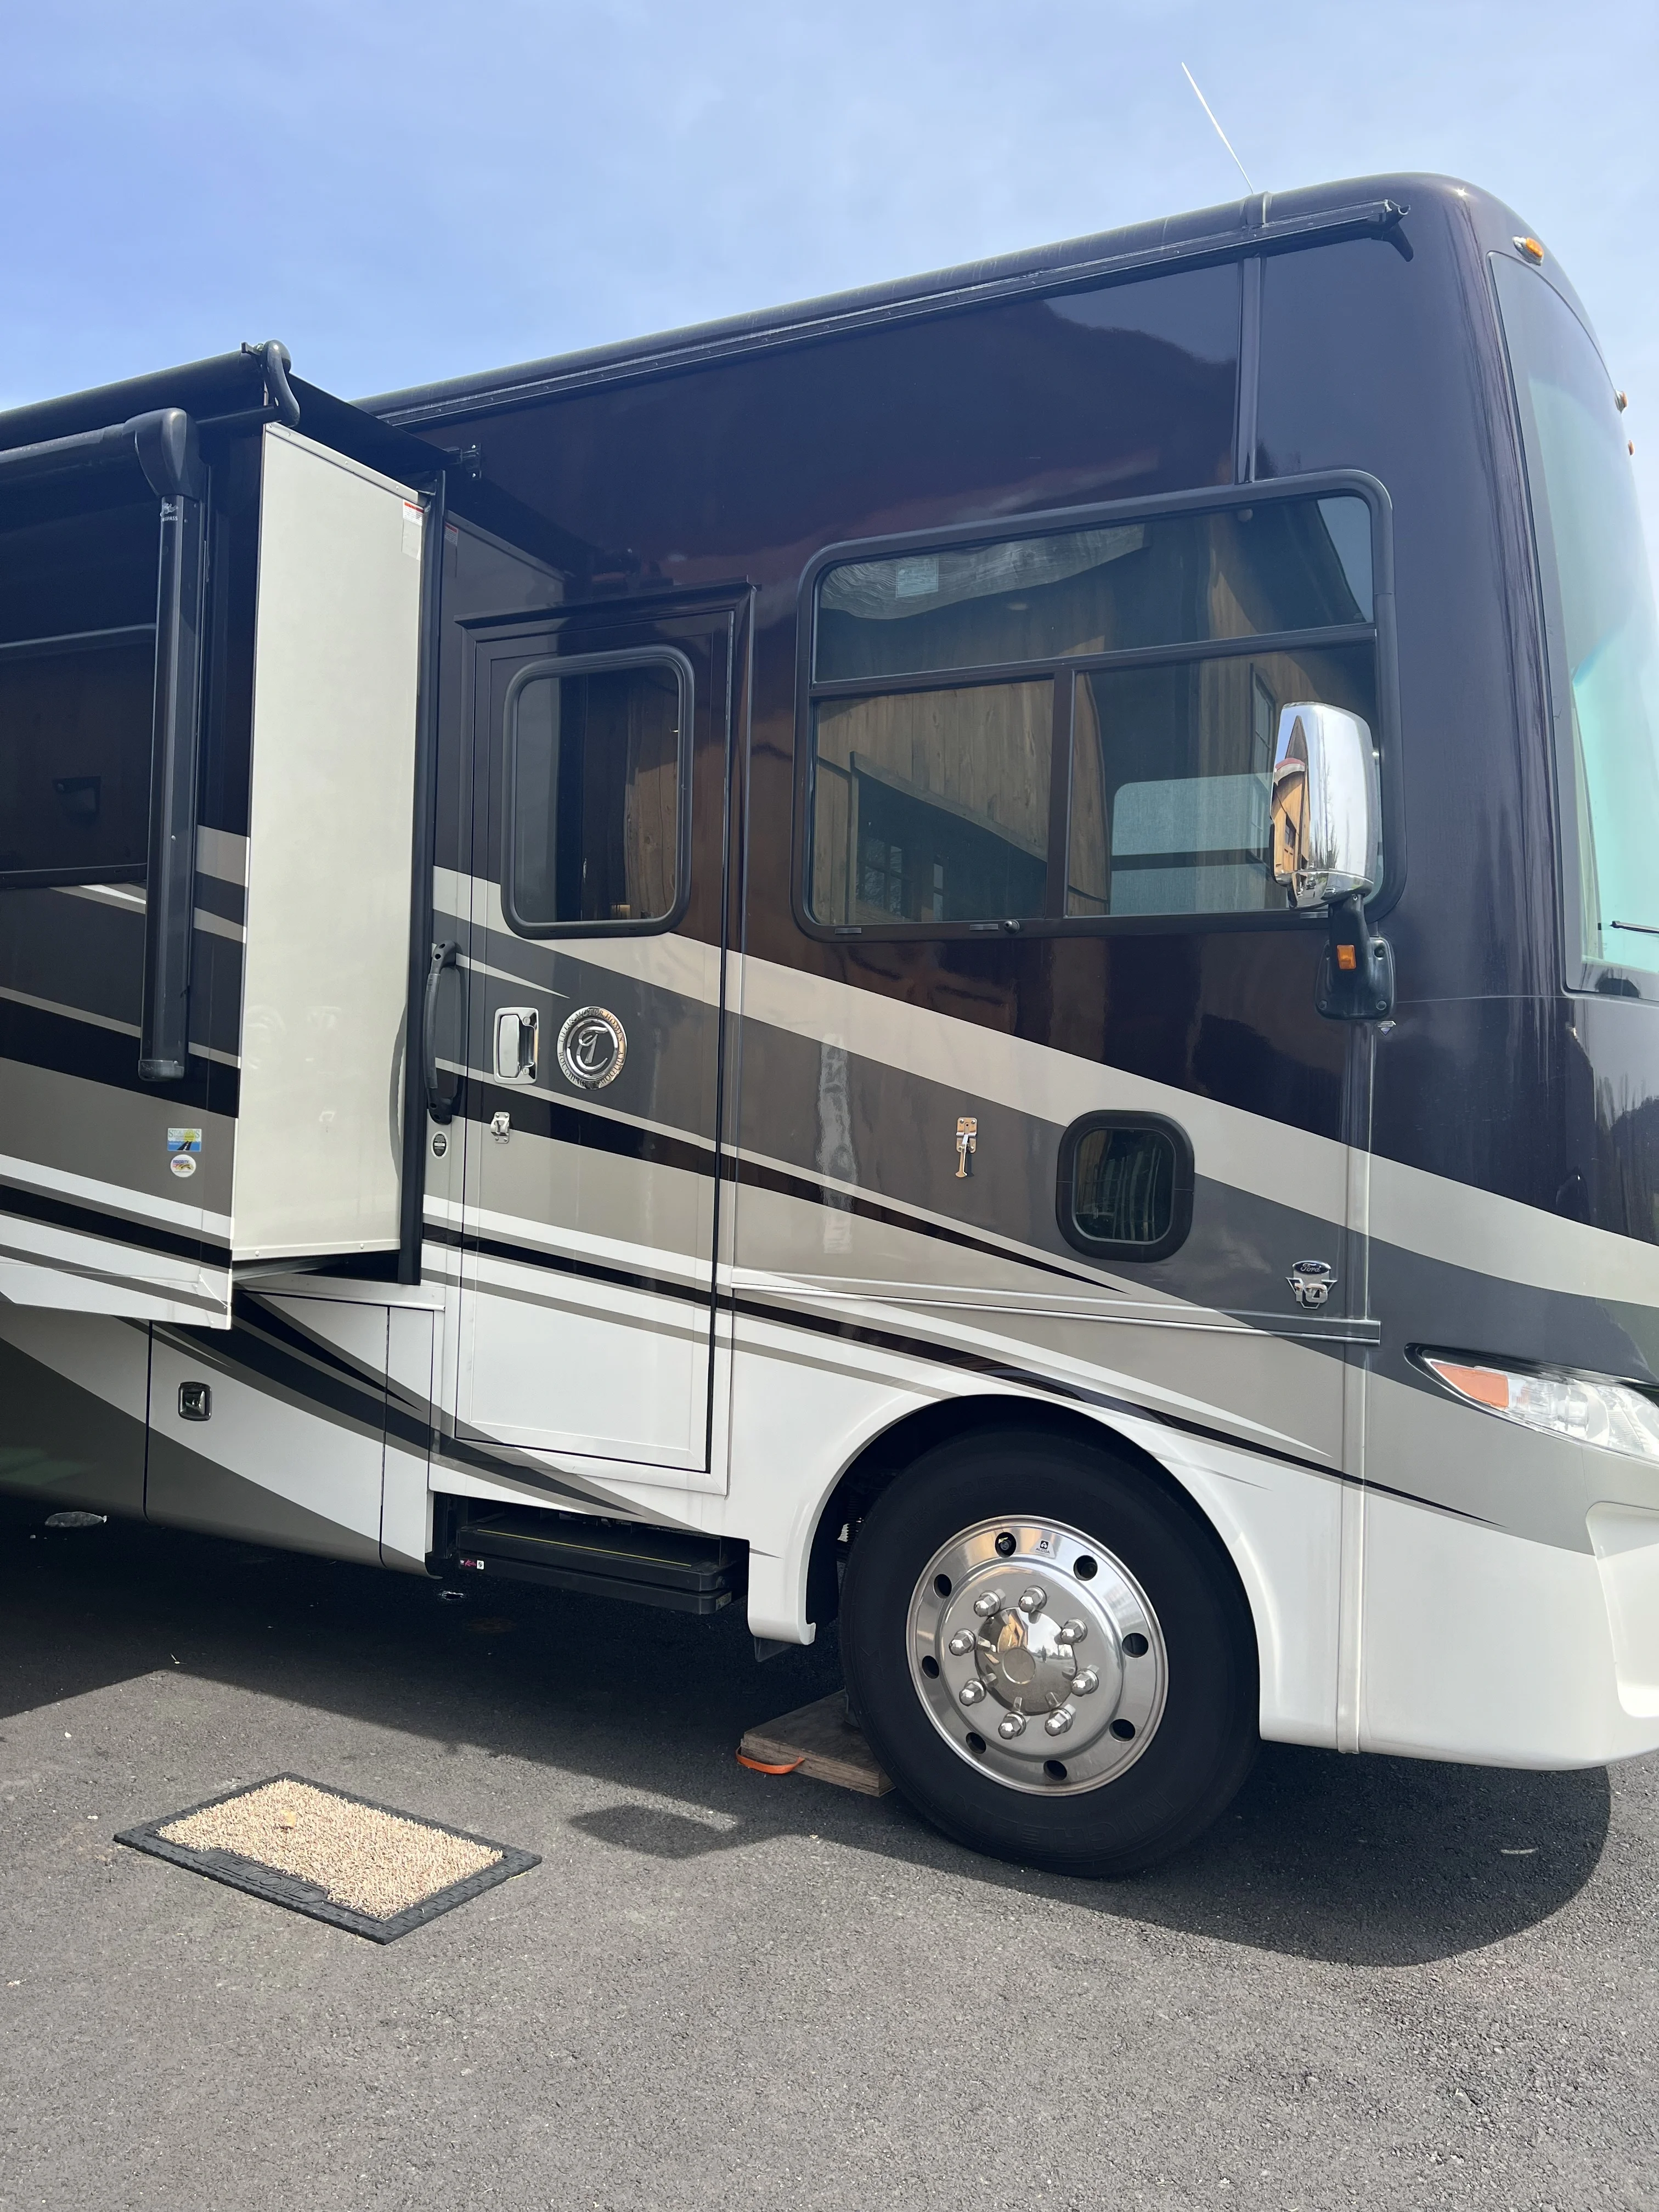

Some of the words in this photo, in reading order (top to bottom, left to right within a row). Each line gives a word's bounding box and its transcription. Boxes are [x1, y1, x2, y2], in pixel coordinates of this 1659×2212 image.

[575, 1008, 603, 1020] MOTOR
[606, 1013, 623, 1042] HOMES
[558, 1052, 585, 1087] ROUGHING
[1300, 1263, 1322, 1272] Ford
[207, 1858, 313, 1899] WELCOME
